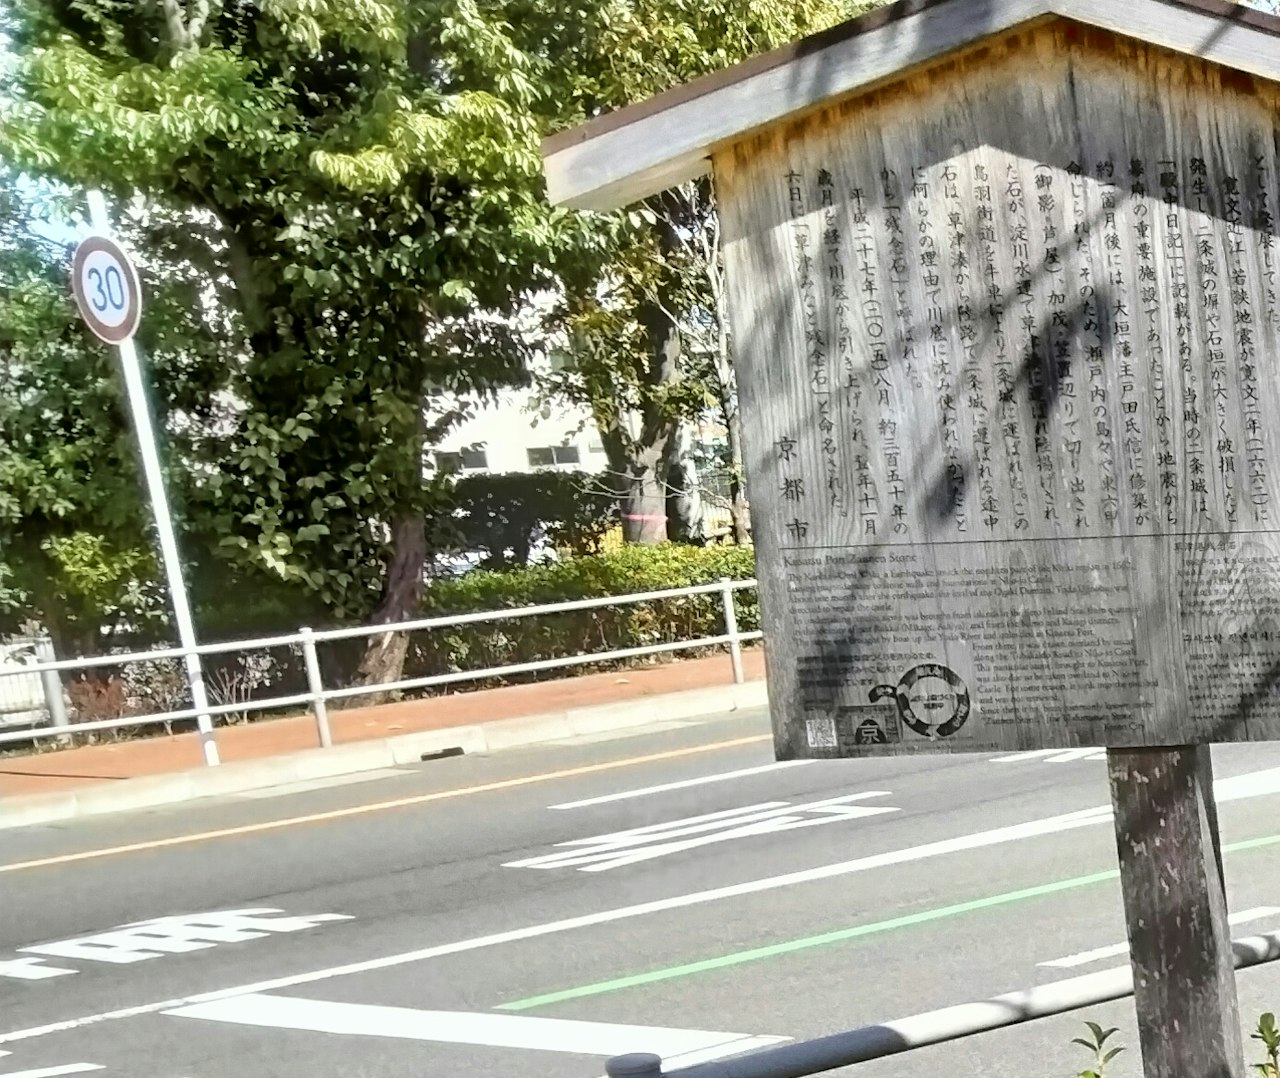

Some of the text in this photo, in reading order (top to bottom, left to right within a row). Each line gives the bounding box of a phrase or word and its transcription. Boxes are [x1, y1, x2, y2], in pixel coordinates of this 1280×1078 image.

[87, 265, 125, 312] 30
[773, 436, 810, 541] 京都市
[859, 723, 881, 744] 京
